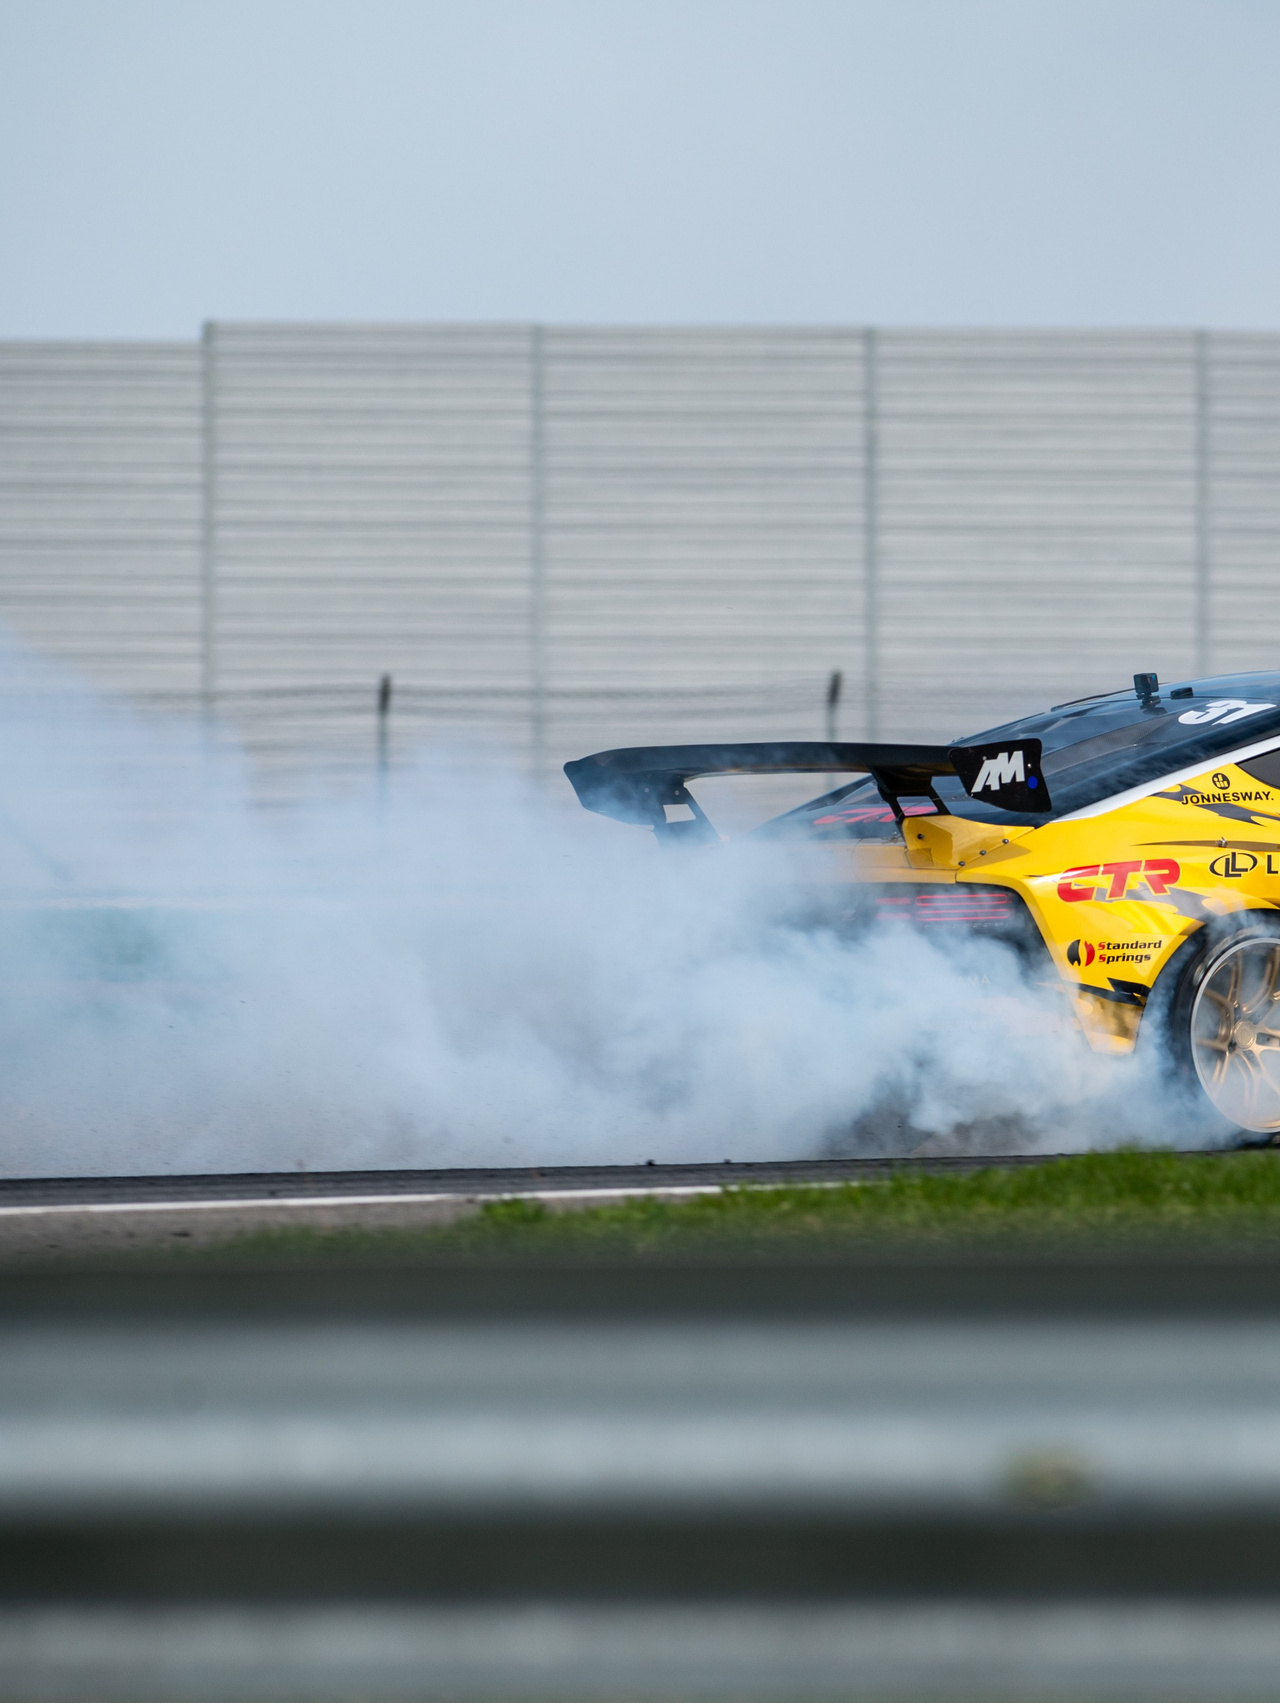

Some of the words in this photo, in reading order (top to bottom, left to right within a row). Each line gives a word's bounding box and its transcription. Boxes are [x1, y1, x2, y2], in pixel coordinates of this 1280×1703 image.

[1057, 858, 1180, 902] CTR
[1098, 940, 1162, 950] Standard
[1098, 953, 1151, 965] Springs
